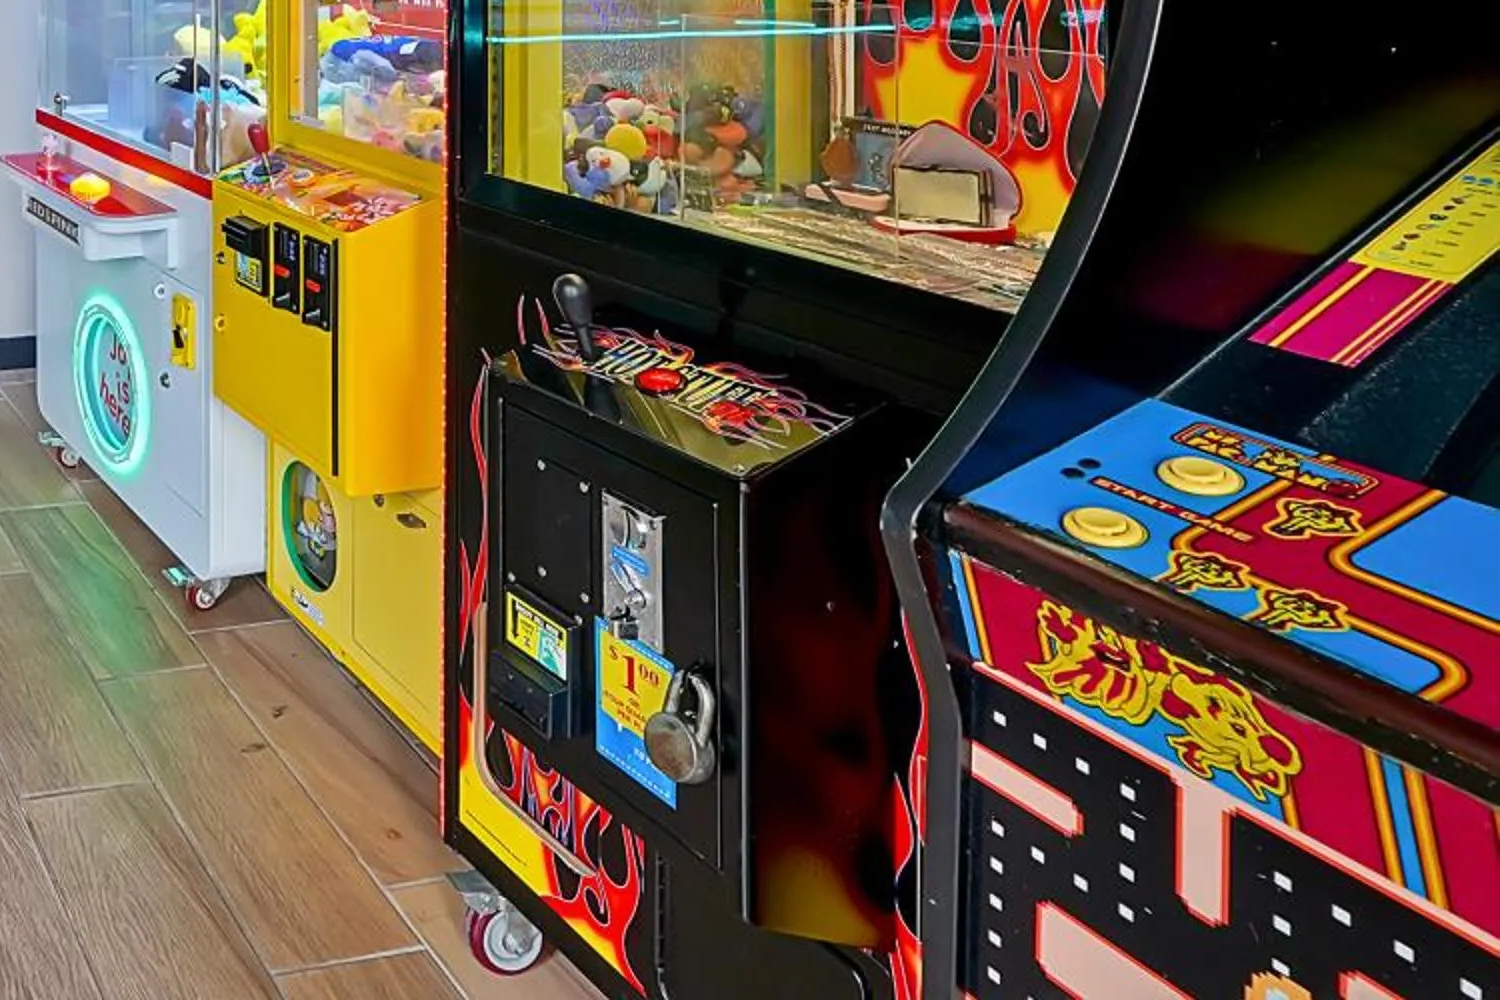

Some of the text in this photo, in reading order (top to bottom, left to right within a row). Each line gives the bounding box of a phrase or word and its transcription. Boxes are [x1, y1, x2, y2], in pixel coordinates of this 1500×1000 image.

[100, 371, 131, 439] here
[116, 370, 130, 405] is
[1095, 476, 1255, 543] START GAME
